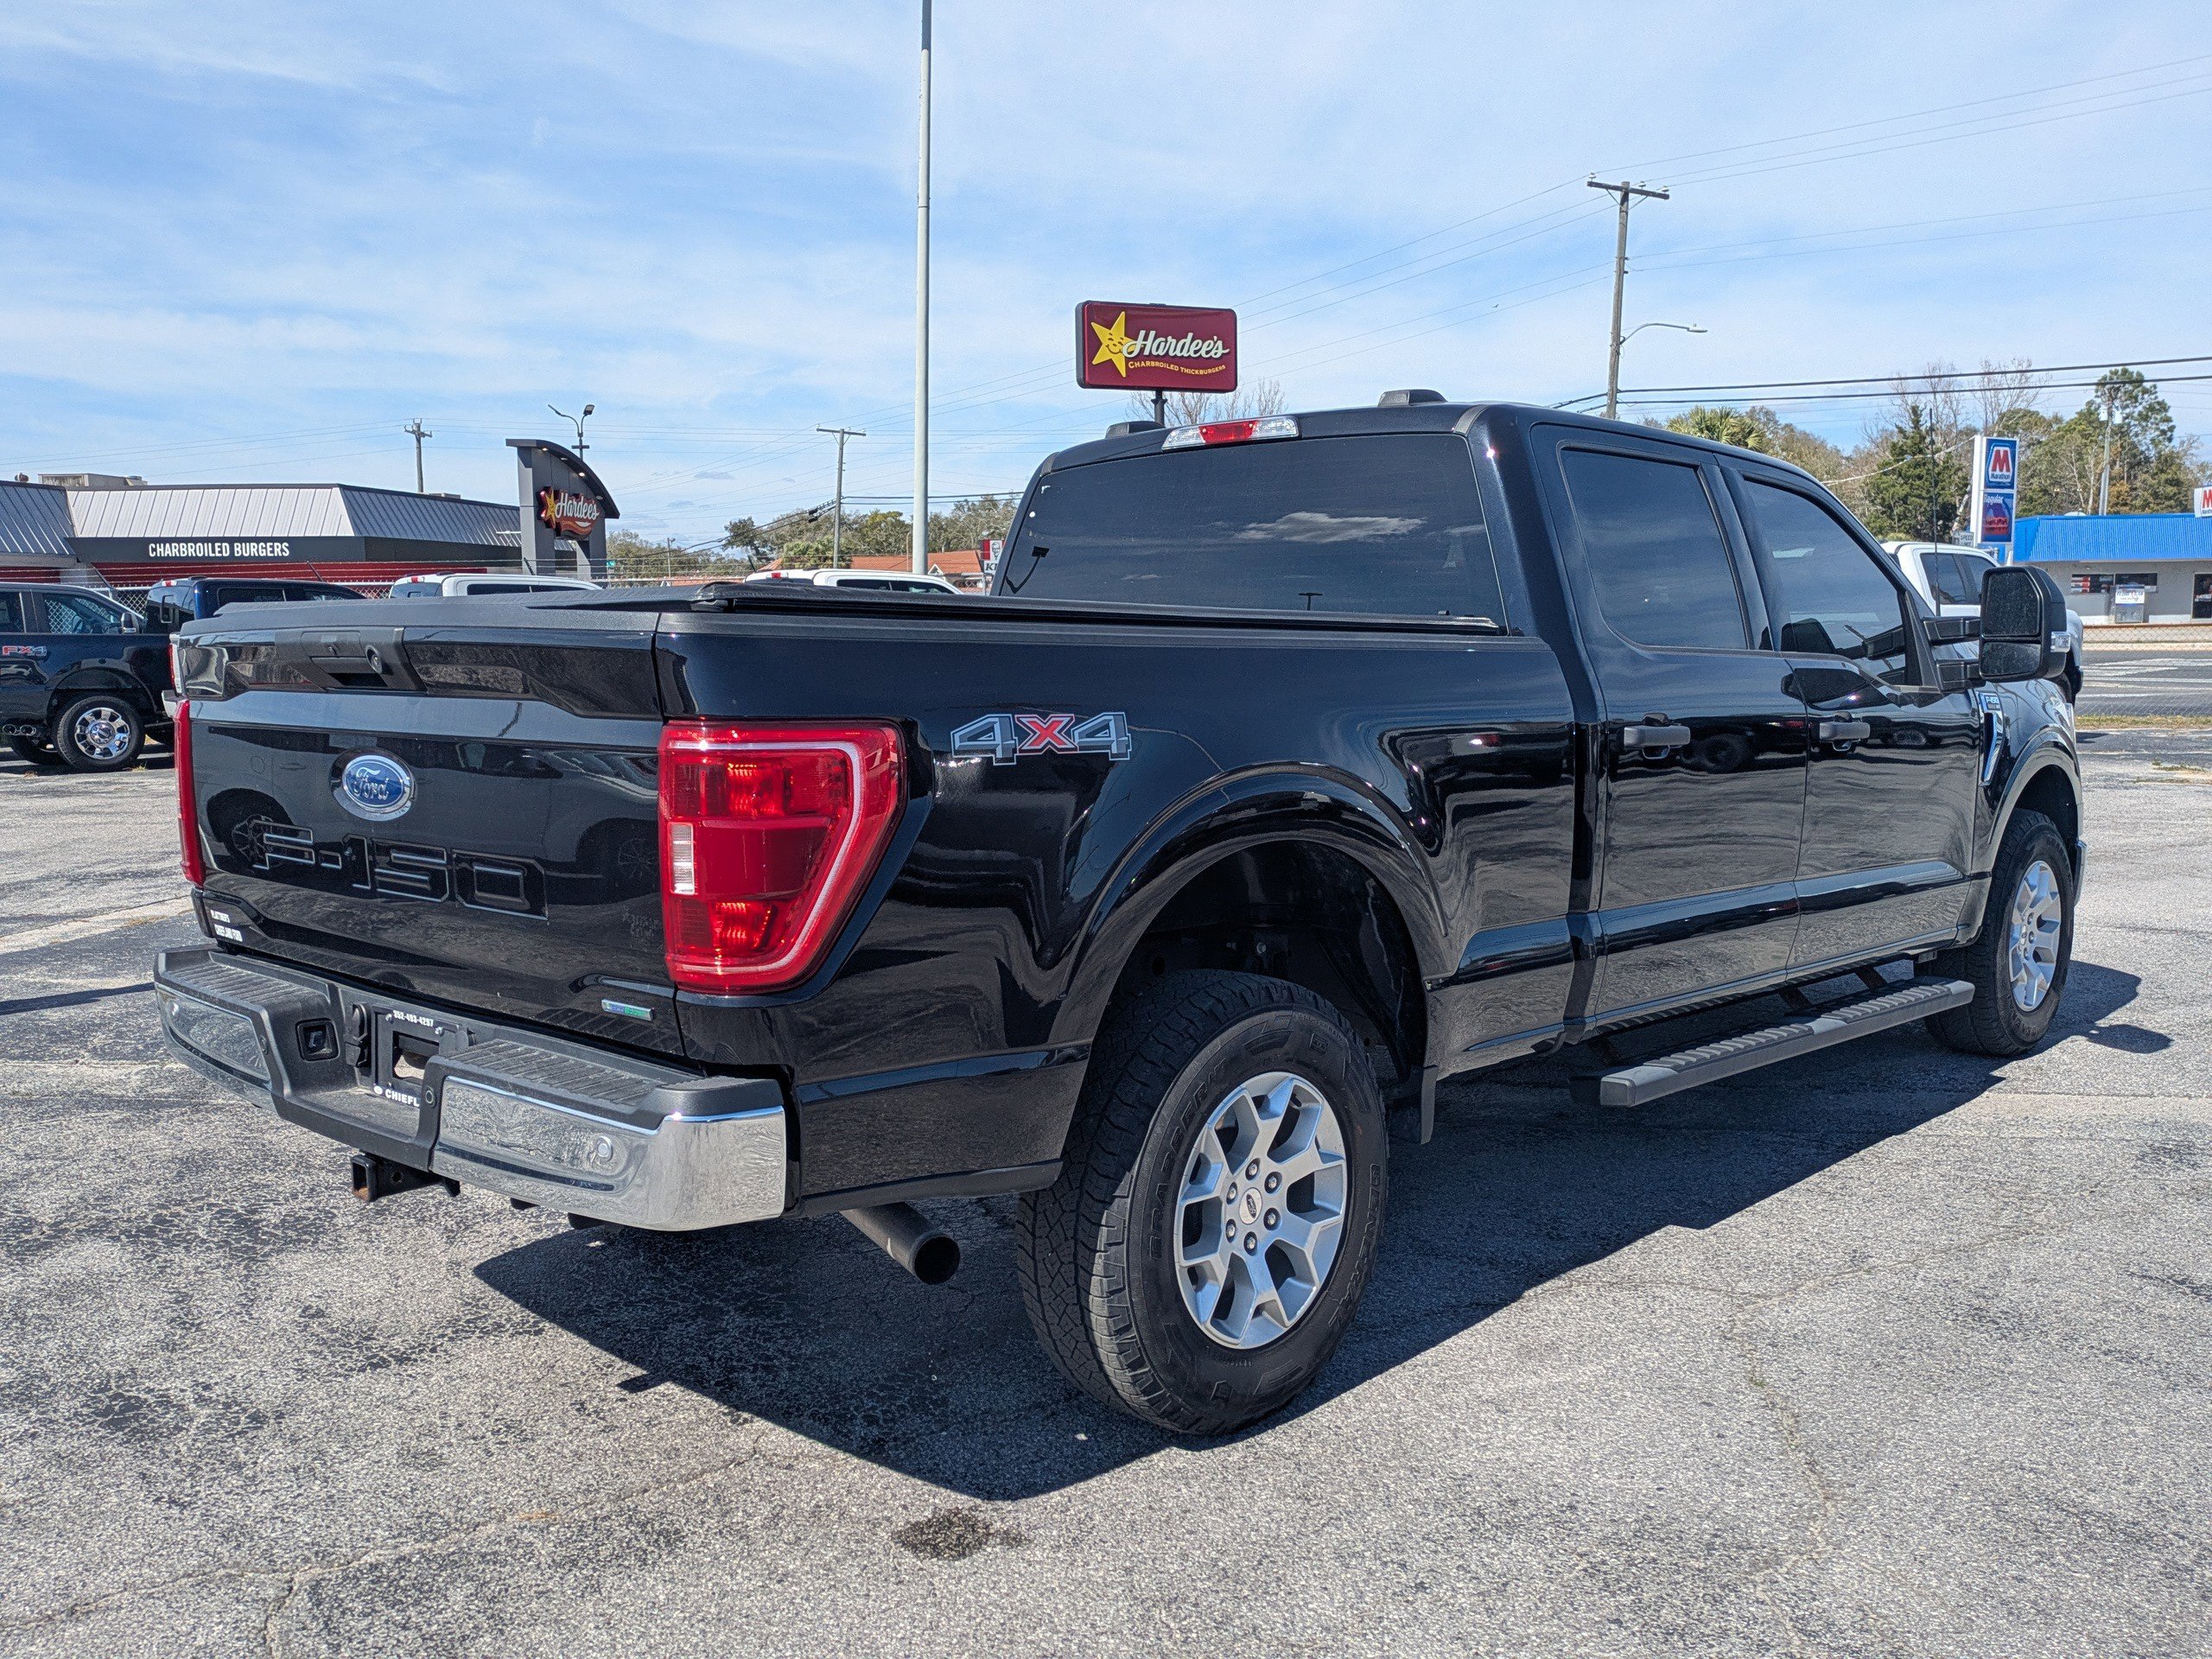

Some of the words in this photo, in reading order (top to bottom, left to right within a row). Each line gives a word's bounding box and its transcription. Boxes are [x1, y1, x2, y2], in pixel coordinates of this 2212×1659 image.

[1122, 329, 1230, 359] Hardee's
[1128, 360, 1180, 372] CHARBROILED
[1180, 364, 1226, 376] THICKBURGERS
[555, 492, 601, 520] Hardee's
[149, 543, 230, 557] CHARBROILED
[233, 542, 290, 557] BURGERS
[2, 645, 48, 657] FX4
[355, 766, 390, 801] Ford
[251, 820, 550, 921] F-150
